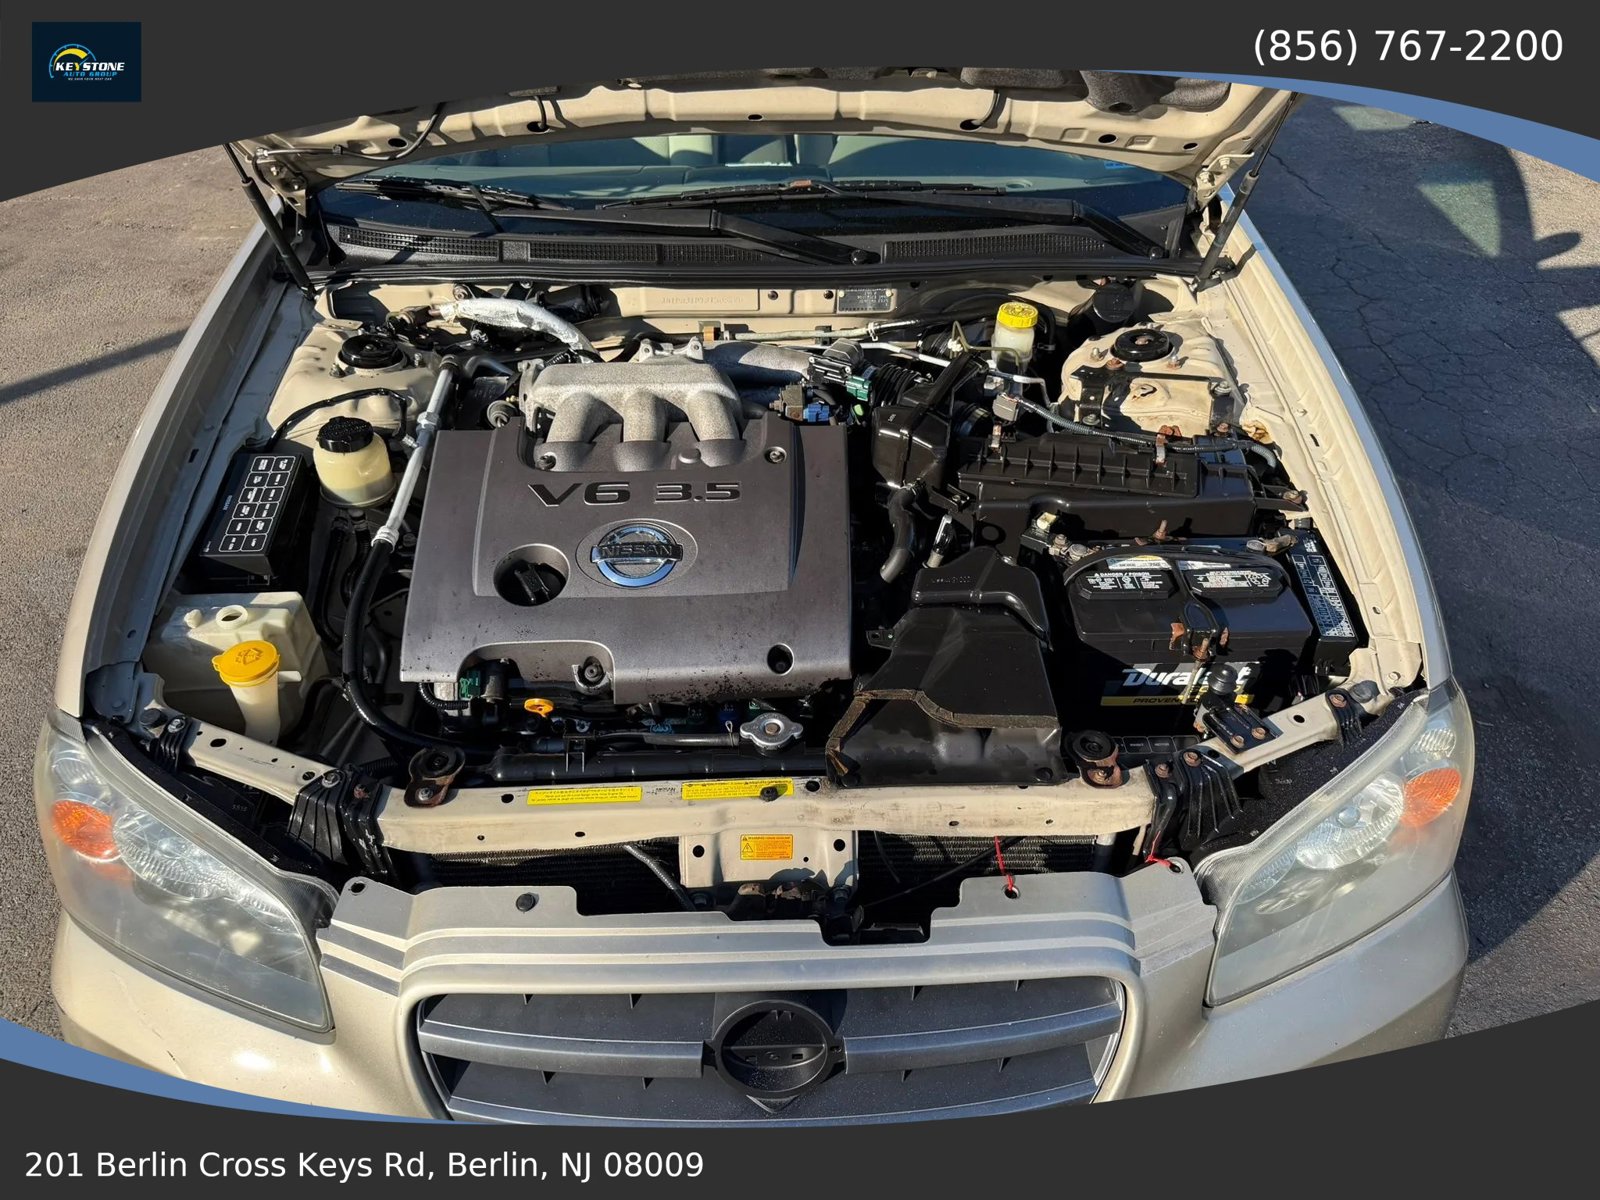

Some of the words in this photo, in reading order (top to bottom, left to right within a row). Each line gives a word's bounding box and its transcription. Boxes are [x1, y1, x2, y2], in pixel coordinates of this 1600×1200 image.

[527, 481, 631, 507] V6
[655, 482, 742, 503] 3.5
[601, 543, 673, 558] NISSAN
[1121, 665, 1252, 687] Duralt
[1132, 696, 1181, 704] PROVEN
